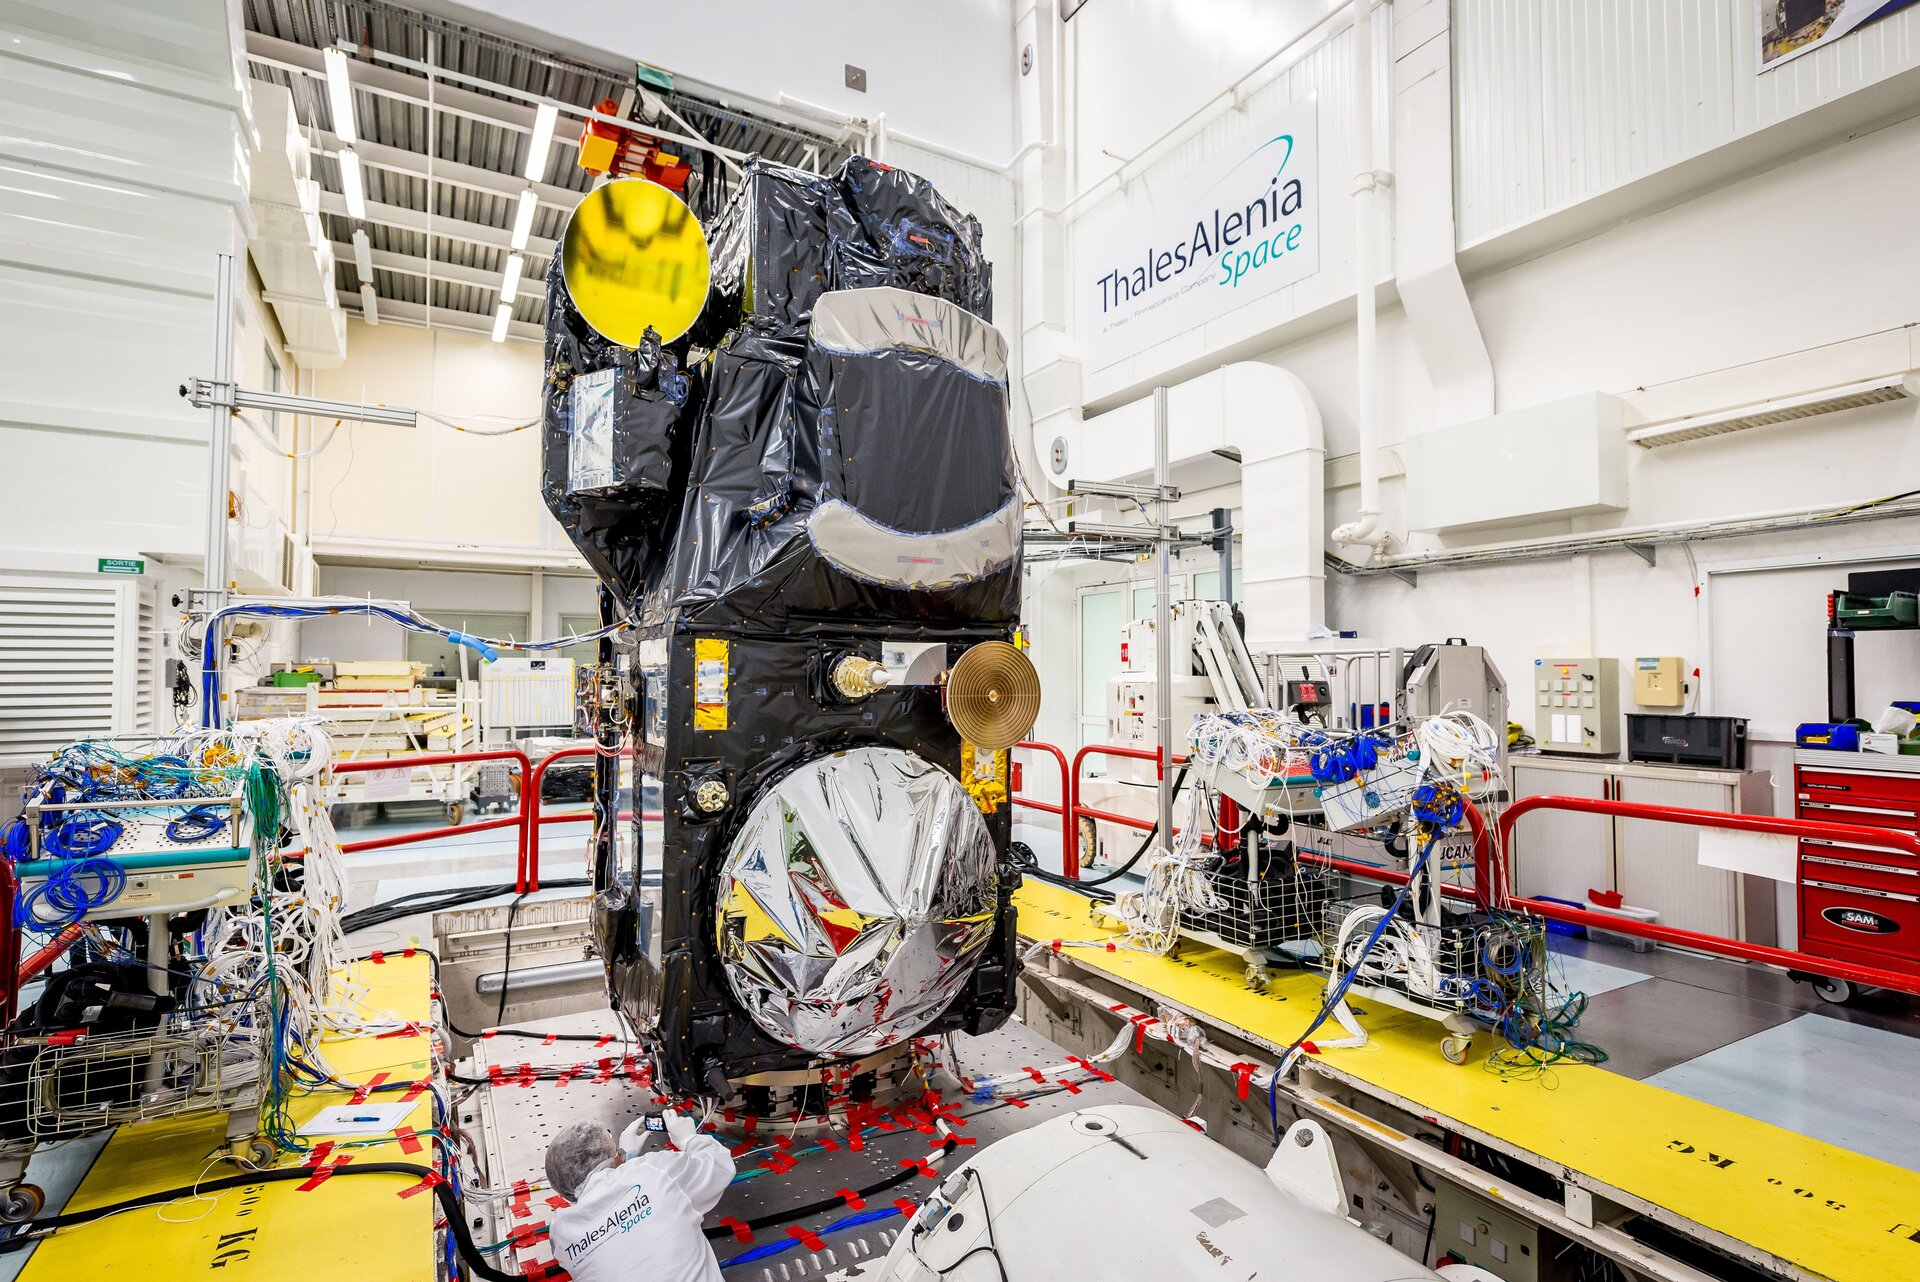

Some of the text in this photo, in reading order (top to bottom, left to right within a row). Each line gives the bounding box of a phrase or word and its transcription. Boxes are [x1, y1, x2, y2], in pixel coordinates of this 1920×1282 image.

[1097, 177, 1302, 313] ThalesAlenia
[1219, 224, 1302, 288] Space
[1846, 912, 1876, 926] SAM
[1666, 1139, 1738, 1170] KG
[565, 1194, 650, 1261] ThalesAlenia
[620, 1206, 652, 1234] Space
[209, 1226, 258, 1270] KG
